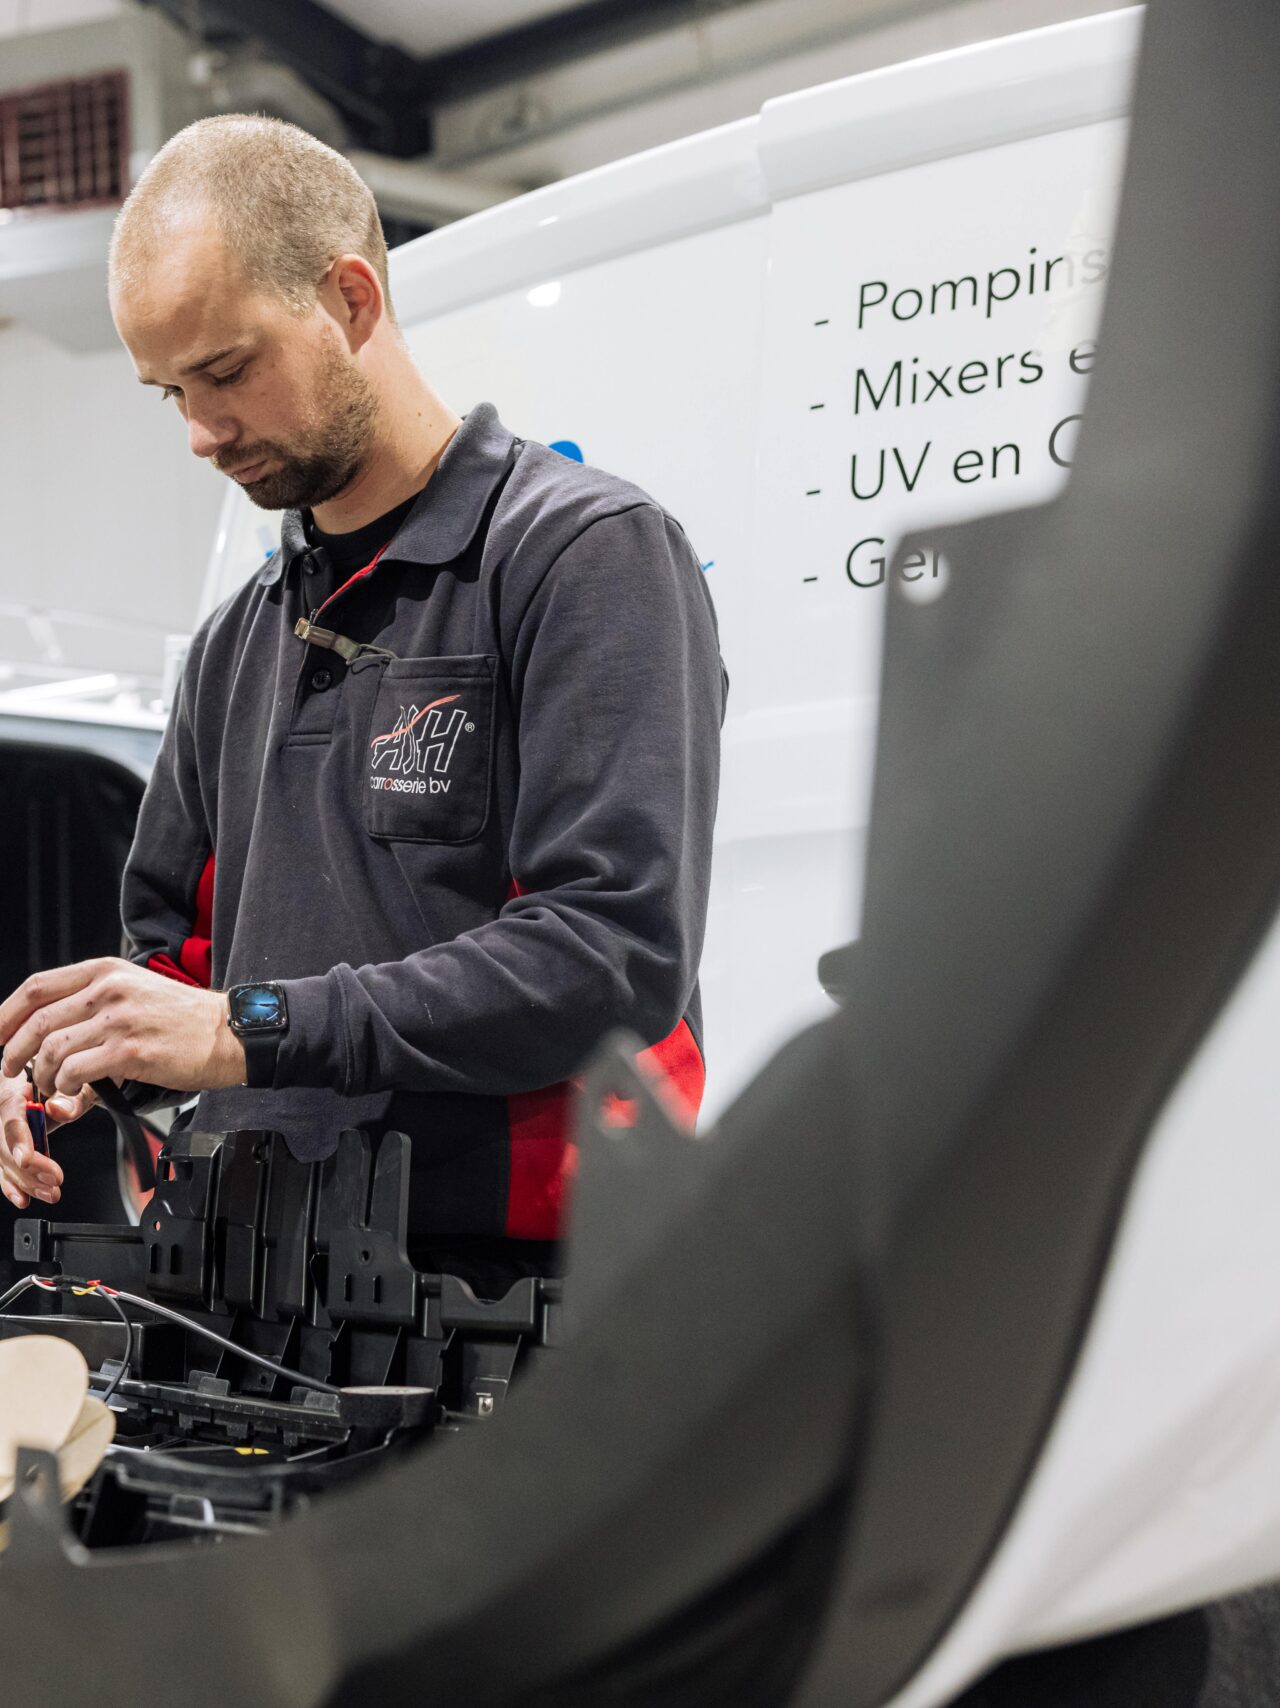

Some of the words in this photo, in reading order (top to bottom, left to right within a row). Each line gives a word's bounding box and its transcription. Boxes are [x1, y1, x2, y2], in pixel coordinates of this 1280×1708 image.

[854, 351, 1044, 415] Mixers
[850, 441, 932, 500] UV
[952, 442, 1021, 483] en
[429, 776, 451, 794] bv
